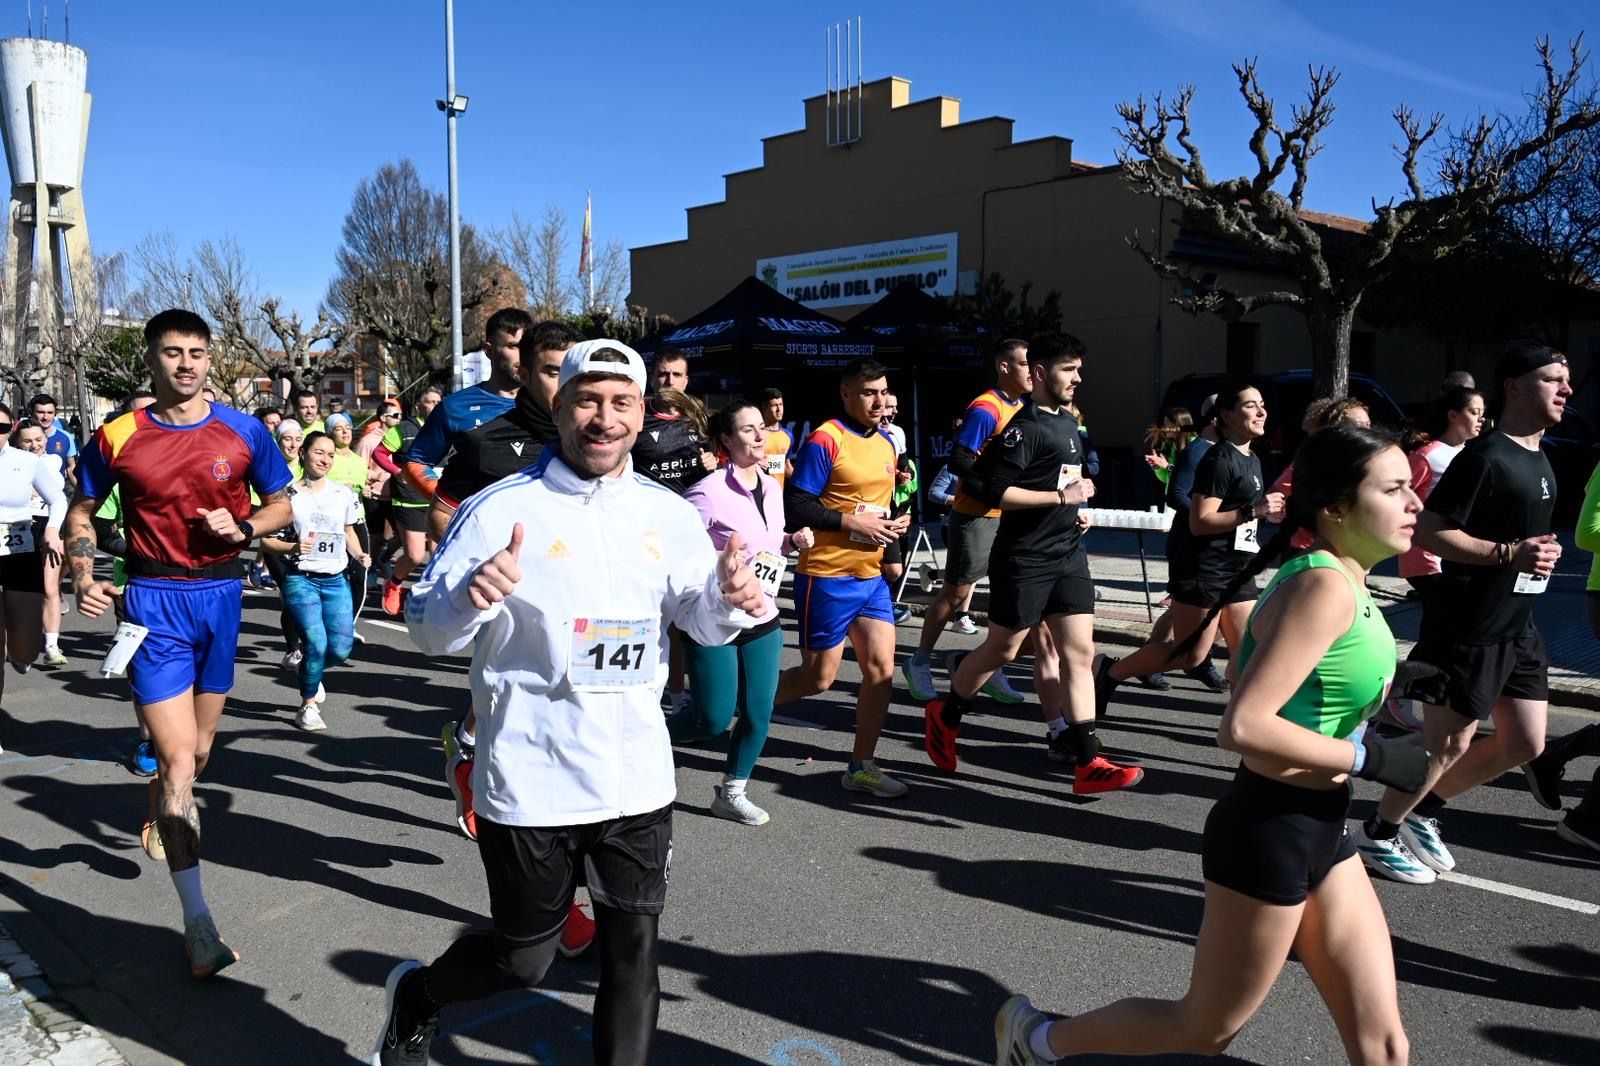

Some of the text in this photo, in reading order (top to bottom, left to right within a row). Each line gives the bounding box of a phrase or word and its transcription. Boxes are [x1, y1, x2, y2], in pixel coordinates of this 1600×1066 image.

[844, 279, 871, 297] DEL
[757, 316, 841, 334] MACHO
[785, 343, 876, 356] SPORTS BARBERSHOP
[318, 542, 335, 553] 81
[754, 562, 777, 584] 274
[588, 643, 646, 670] 147
